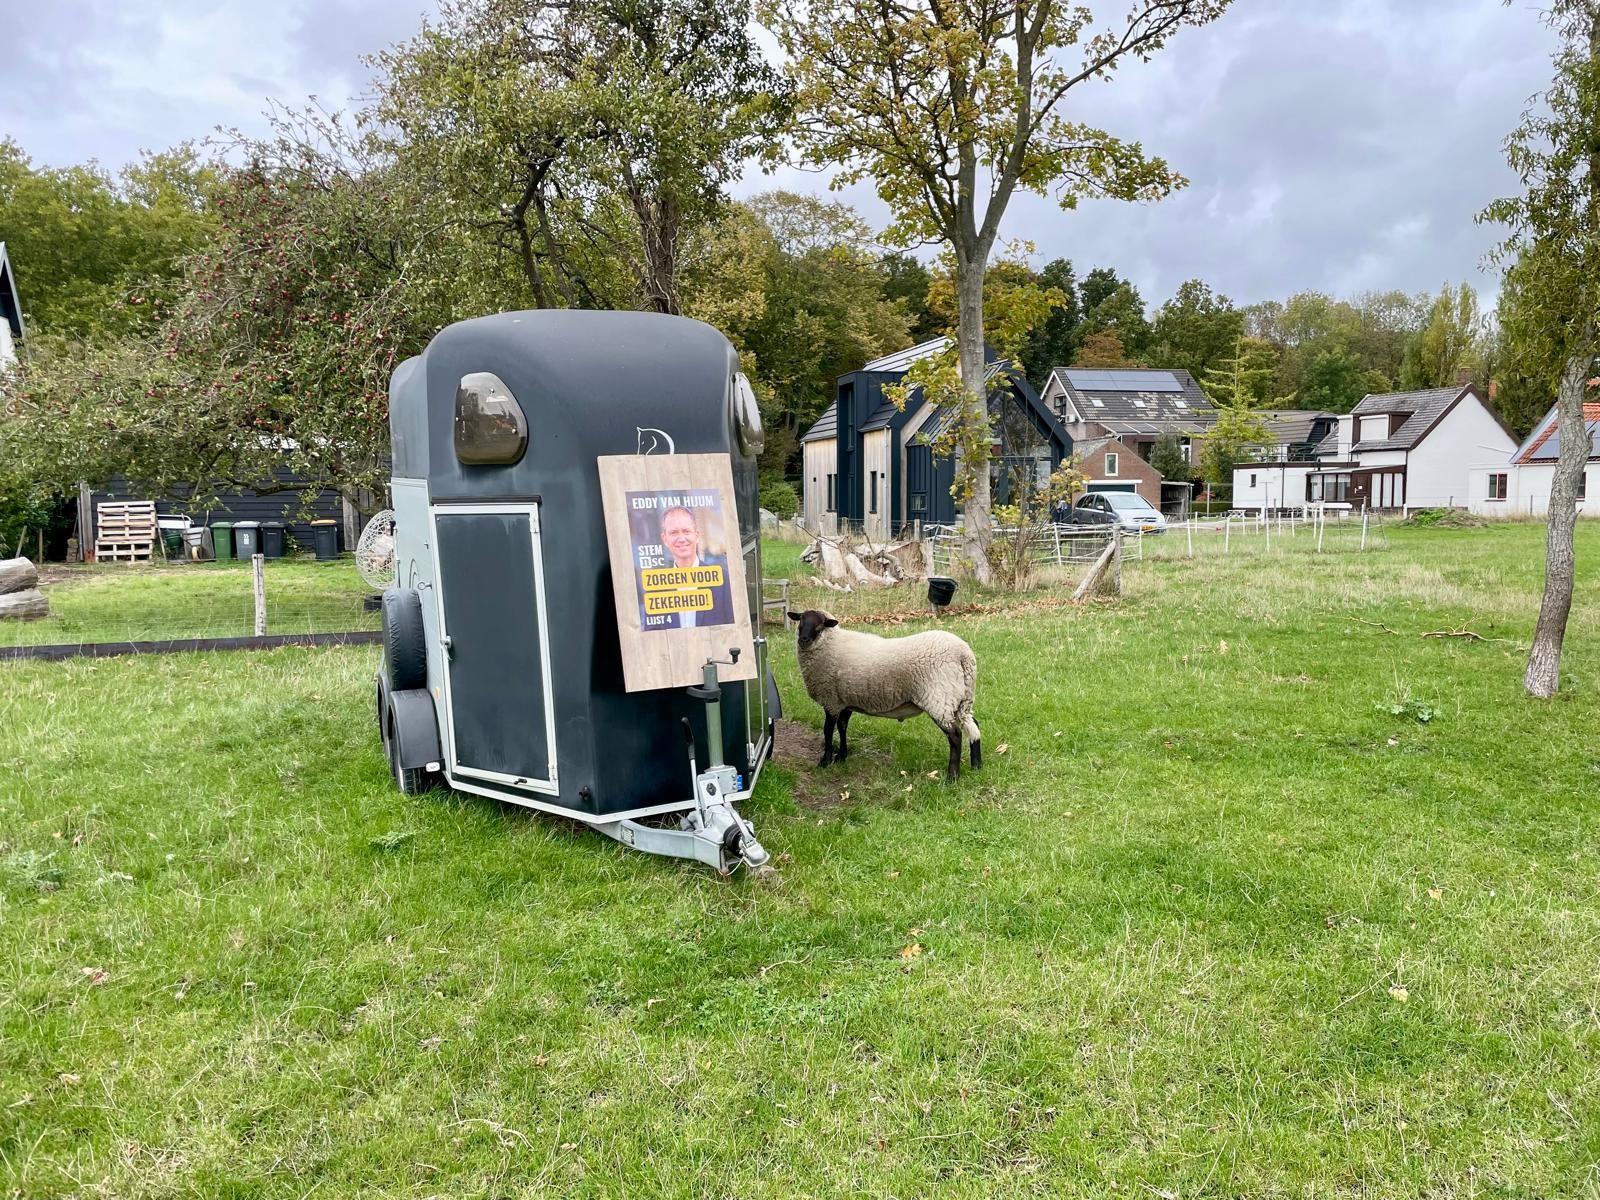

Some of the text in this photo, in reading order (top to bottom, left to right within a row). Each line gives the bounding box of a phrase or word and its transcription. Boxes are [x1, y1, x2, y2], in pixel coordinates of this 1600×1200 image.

[632, 495, 714, 510] EDDY VAN HIJUM
[638, 545, 663, 556] STEM
[646, 570, 719, 586] ZORGEN VOOR
[648, 594, 709, 610] ZEKERHEID!
[646, 615, 672, 625] LIJST 4
